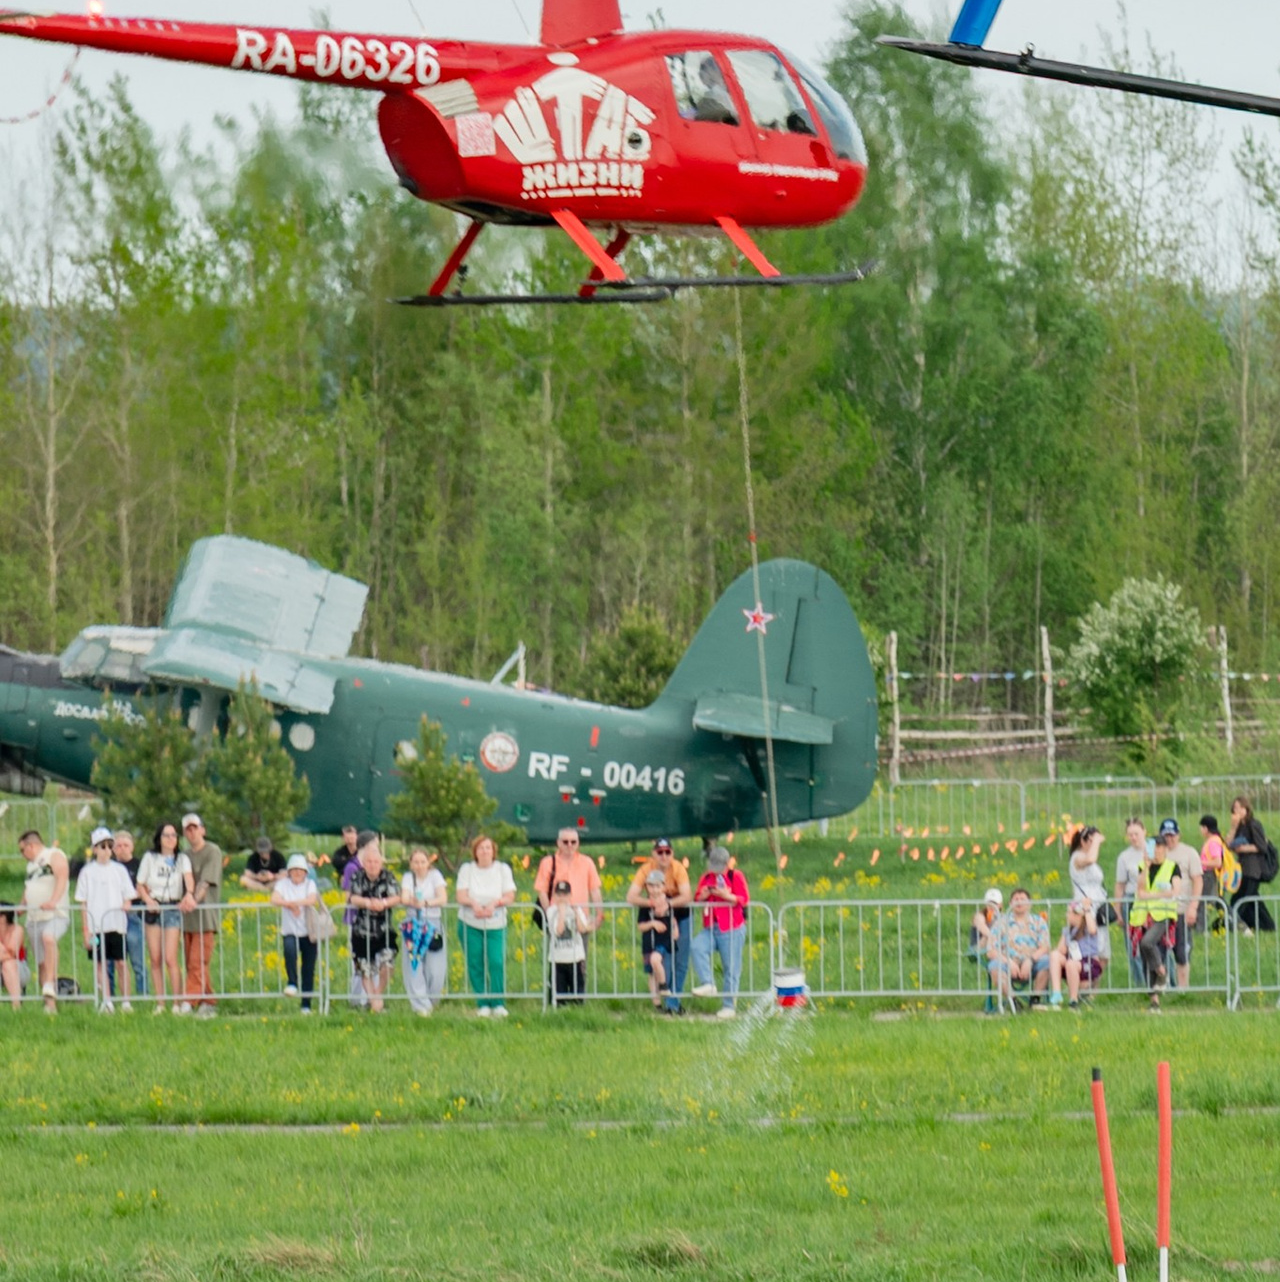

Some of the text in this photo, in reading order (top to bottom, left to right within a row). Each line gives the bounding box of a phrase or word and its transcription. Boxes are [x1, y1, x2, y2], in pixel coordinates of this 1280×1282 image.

[231, 28, 441, 86] RA-06326
[521, 161, 645, 190] ЖИЗНИ
[603, 761, 685, 796] 00416
